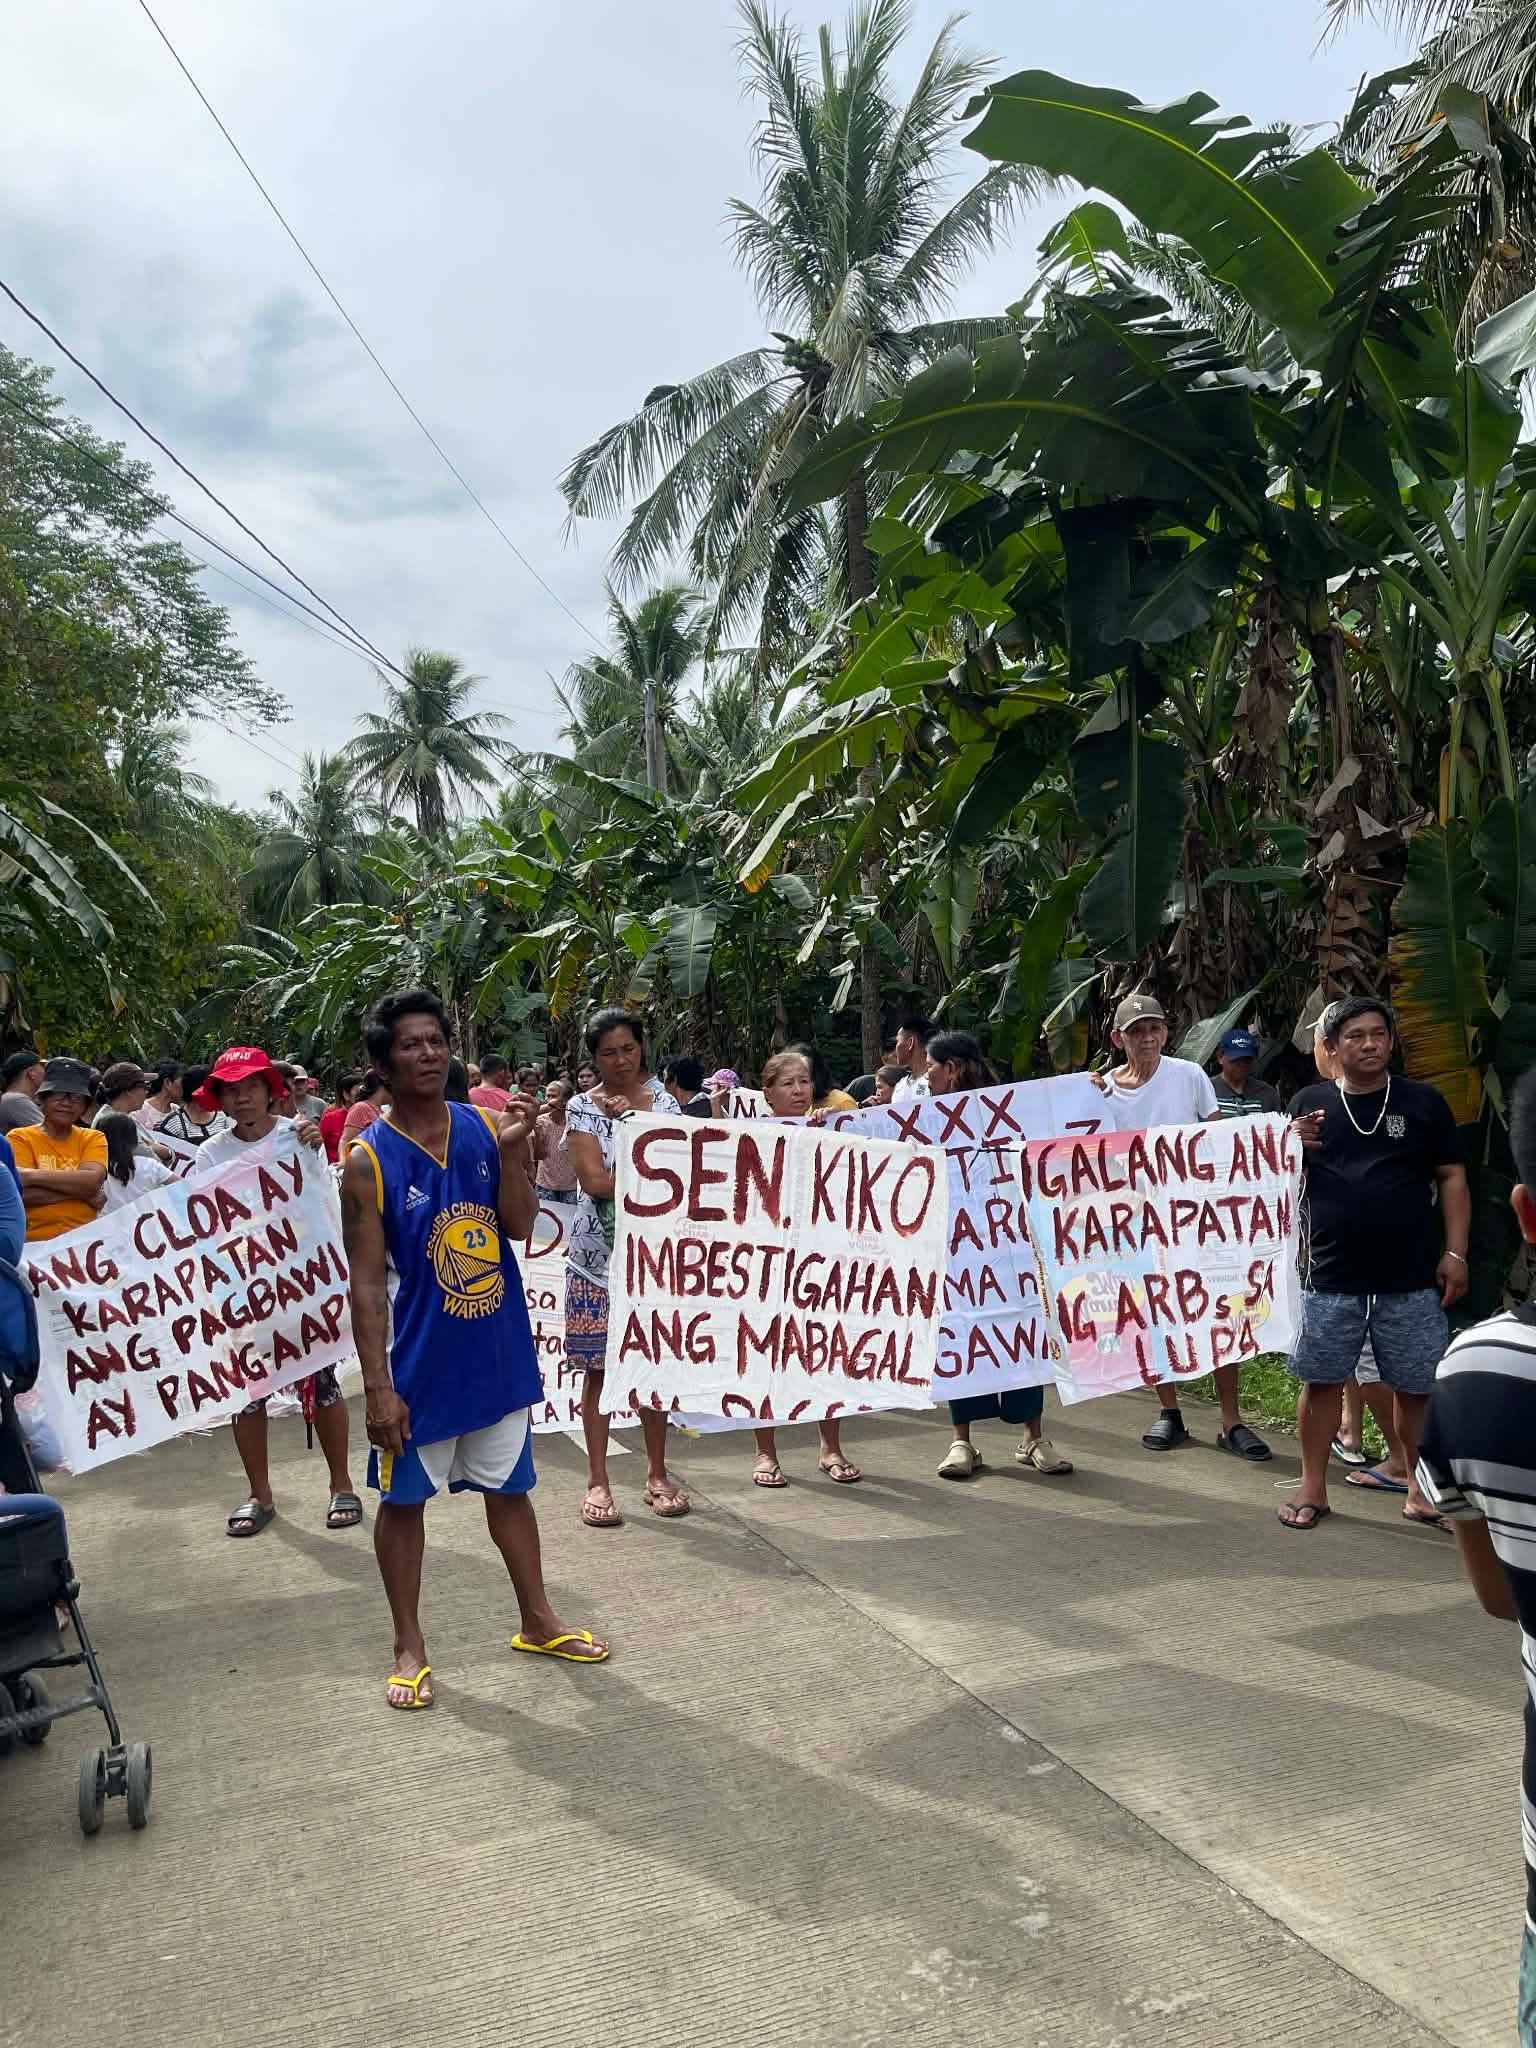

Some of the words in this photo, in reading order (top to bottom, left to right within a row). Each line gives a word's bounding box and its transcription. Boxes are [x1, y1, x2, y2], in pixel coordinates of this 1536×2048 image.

[624, 1127, 791, 1229] SEN.
[812, 1140, 935, 1239] KIKO
[1020, 1129, 1215, 1202] IGALANG
[1229, 1123, 1295, 1184] ANG
[27, 1240, 119, 1297] ANG
[134, 1185, 252, 1260] CLOA
[257, 1152, 303, 1211] AY
[1054, 1189, 1292, 1265] KARAPATAN
[62, 1217, 297, 1338] KARAPATAN
[66, 1333, 161, 1395] ANG
[171, 1241, 348, 1354] PAGBAWI
[626, 1232, 937, 1319] IMBESTIGAHAN
[87, 1389, 137, 1450] AY
[156, 1288, 351, 1420] PANG-AAP
[619, 1309, 717, 1366] ANG
[737, 1312, 931, 1386] MABAGAL
[1136, 1319, 1260, 1385] LUPA
